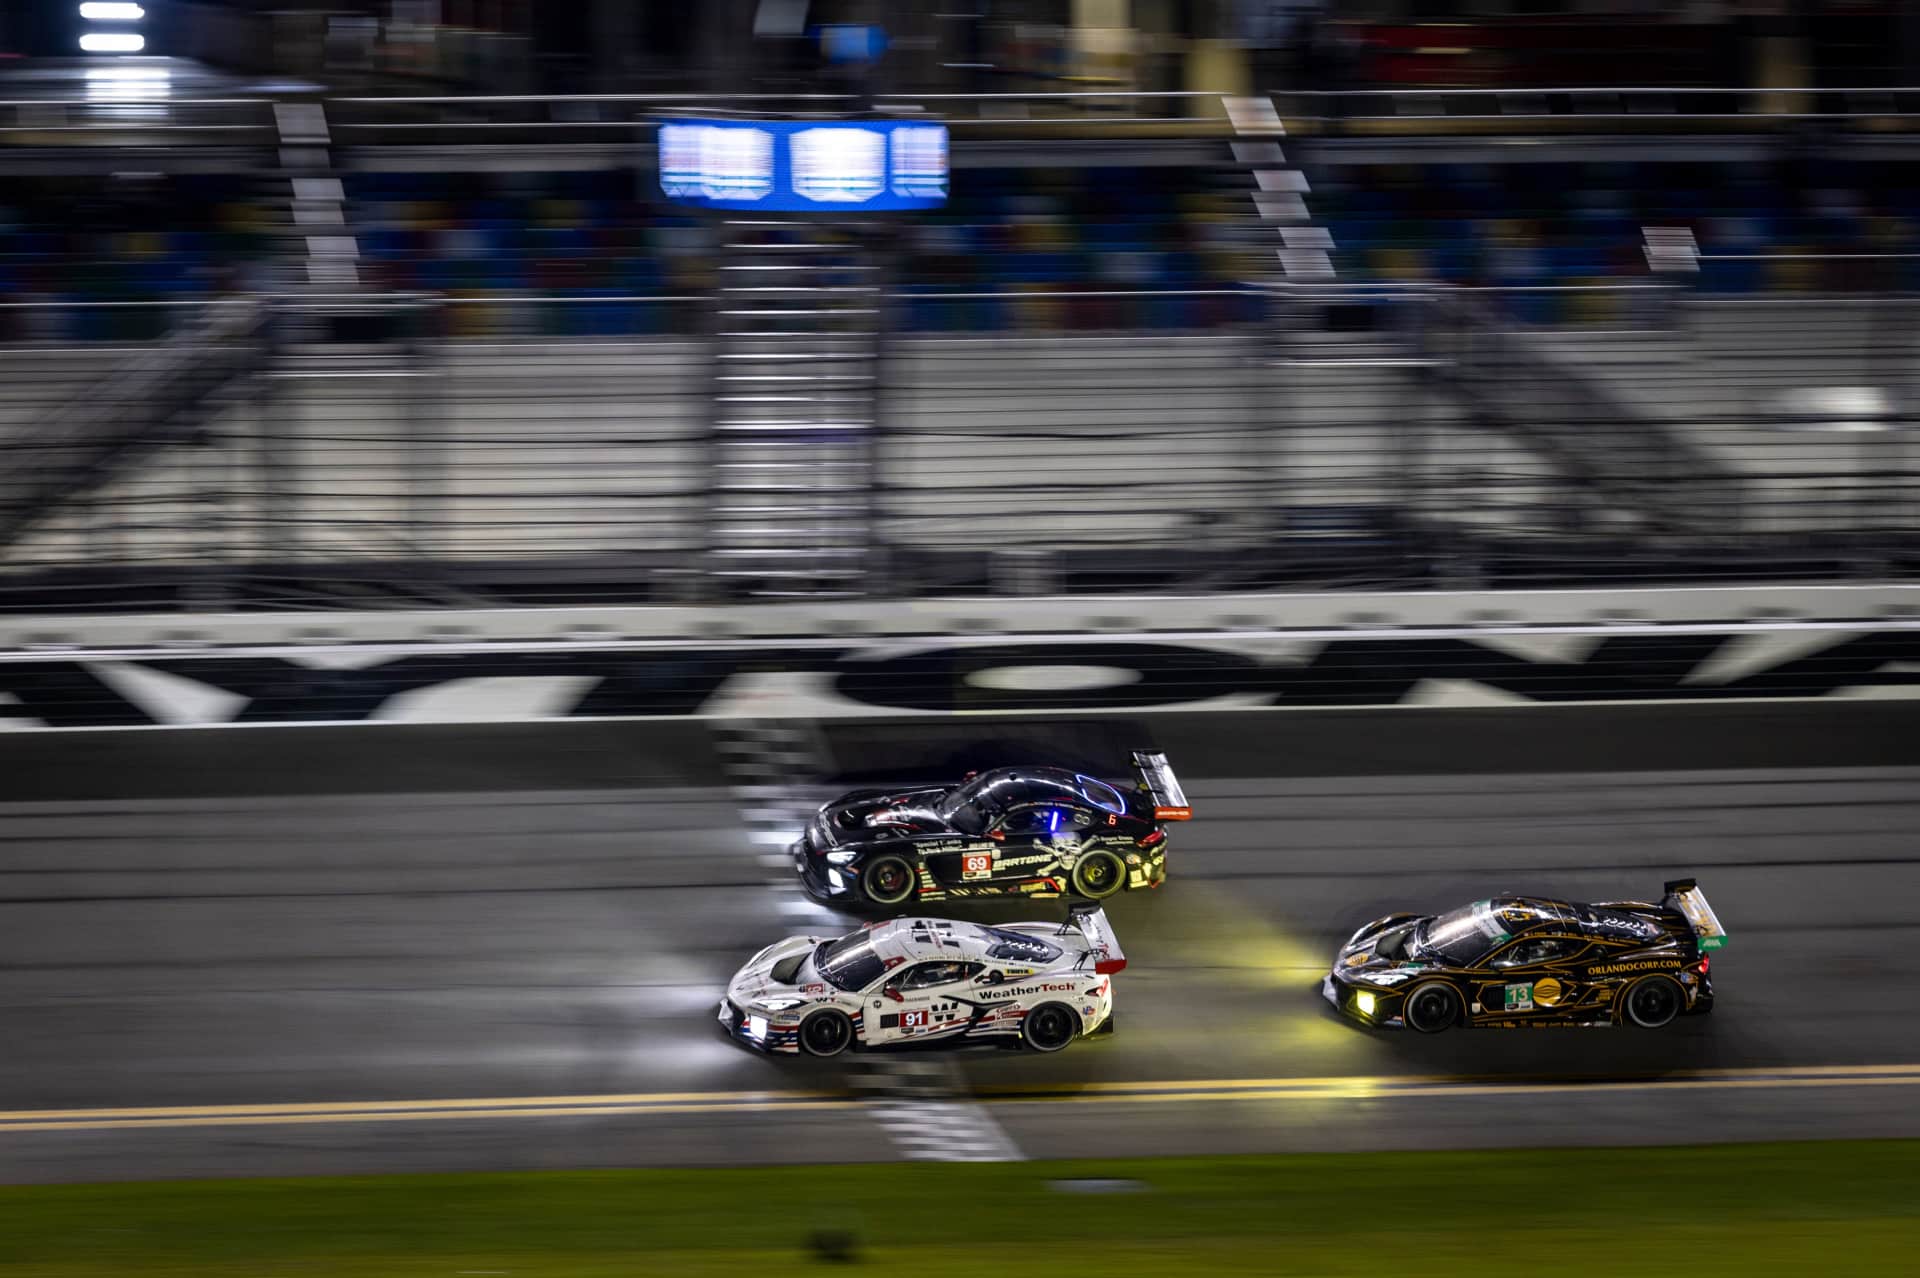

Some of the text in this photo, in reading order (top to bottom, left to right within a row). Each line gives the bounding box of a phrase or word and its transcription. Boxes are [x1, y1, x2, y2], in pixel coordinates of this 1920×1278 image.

[1108, 814, 1117, 826] 6
[966, 856, 988, 871] 69
[1587, 960, 1682, 975] ORLANDOCORP.COM
[978, 982, 1075, 1000] WeatherTech
[1509, 988, 1529, 1002] 13
[905, 1012, 923, 1026] 91
